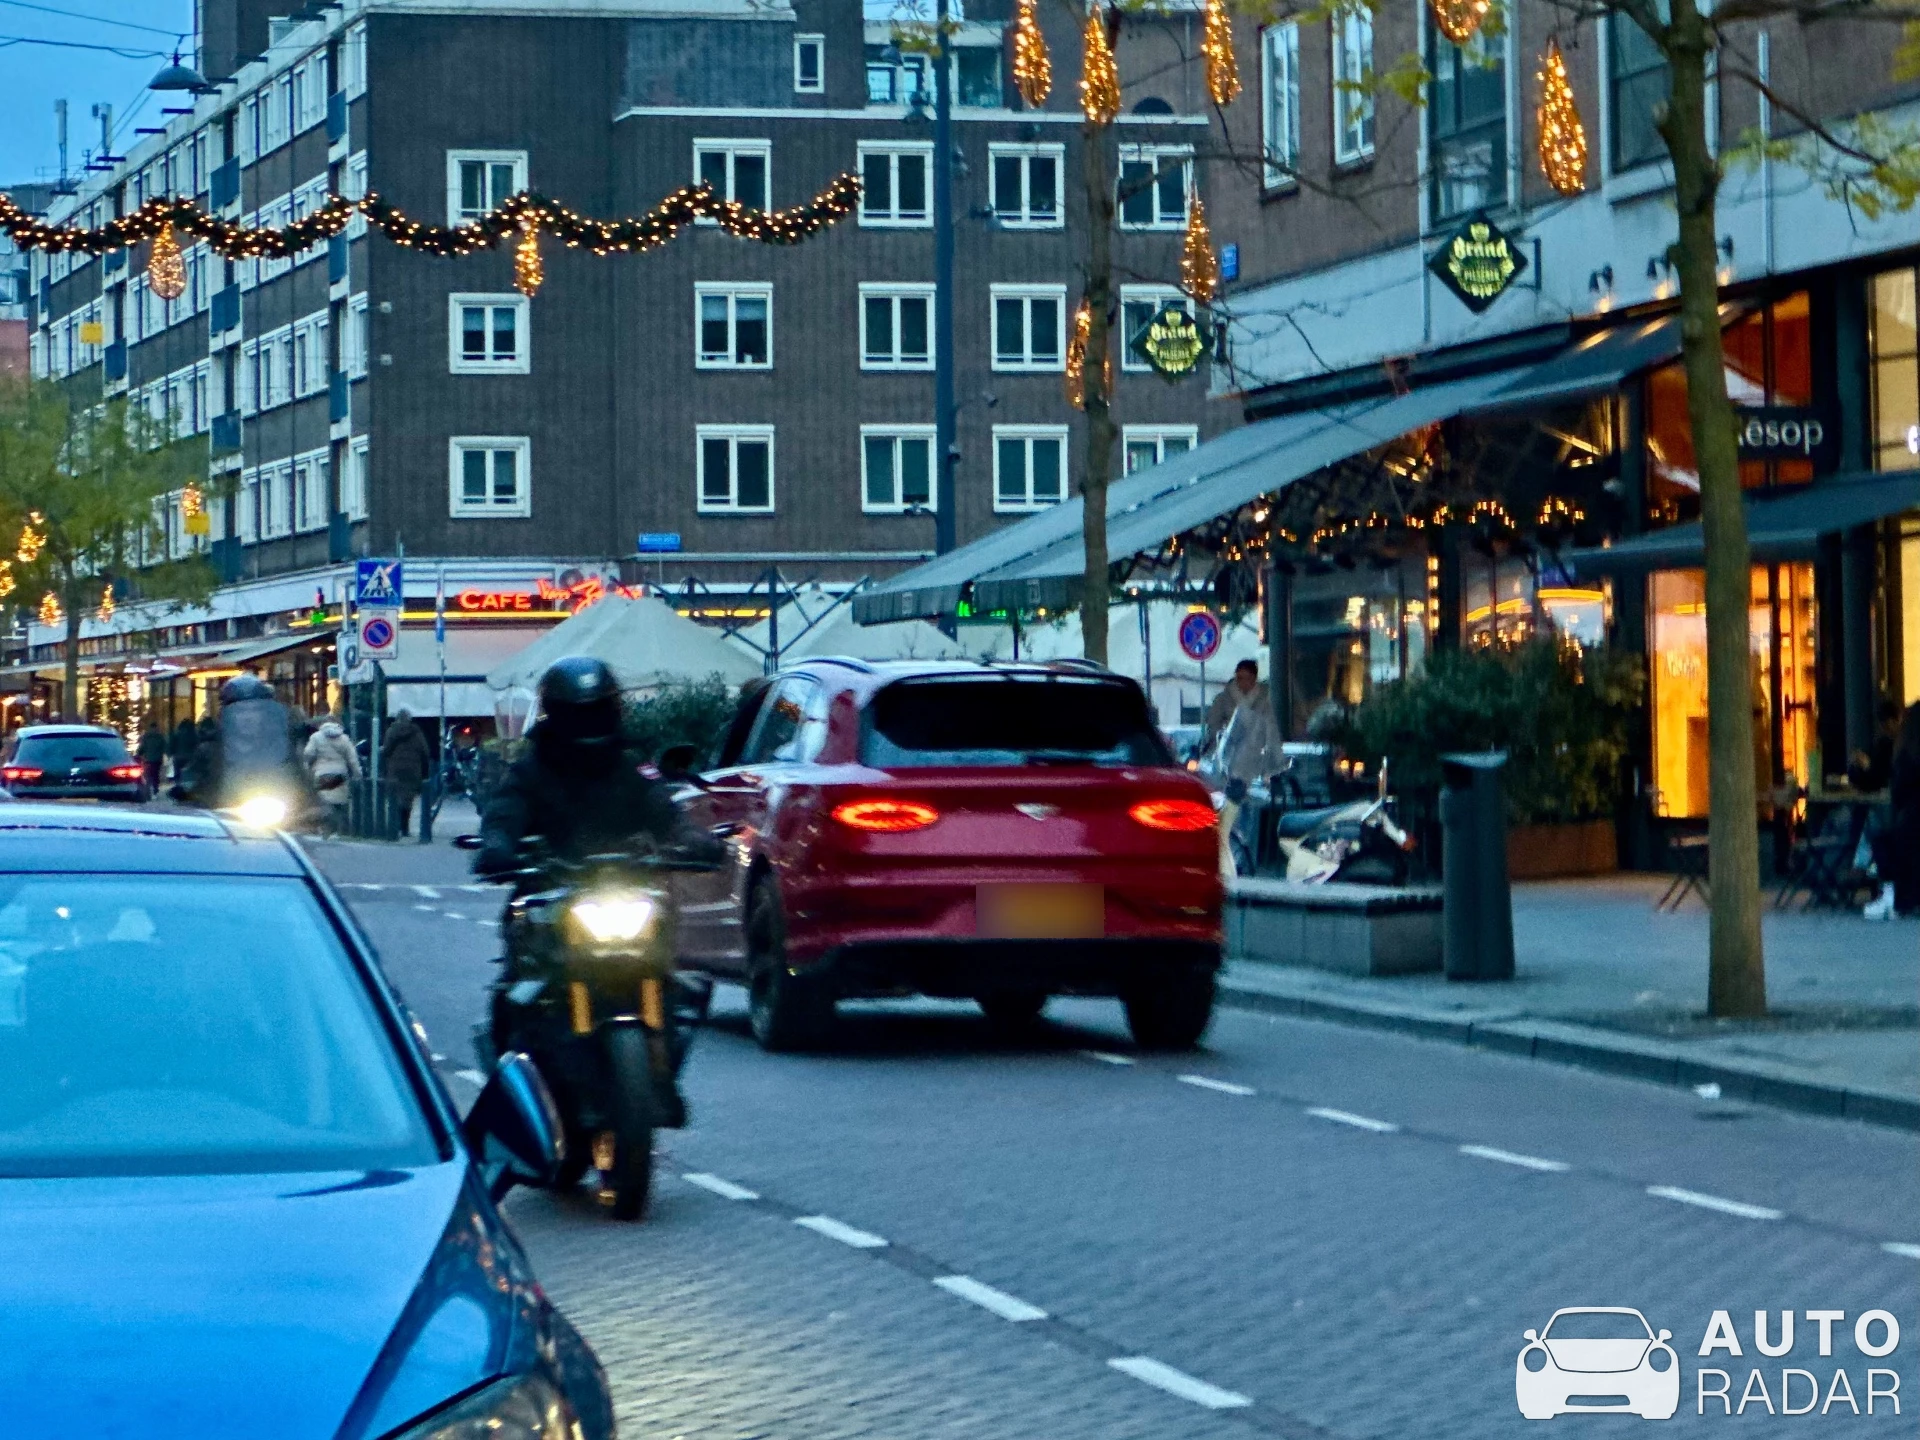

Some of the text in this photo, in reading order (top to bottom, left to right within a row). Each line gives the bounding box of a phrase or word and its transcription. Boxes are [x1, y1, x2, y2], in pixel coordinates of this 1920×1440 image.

[1453, 237, 1508, 259] Brand
[1151, 323, 1197, 341] Brand
[460, 589, 532, 610] CAFE
